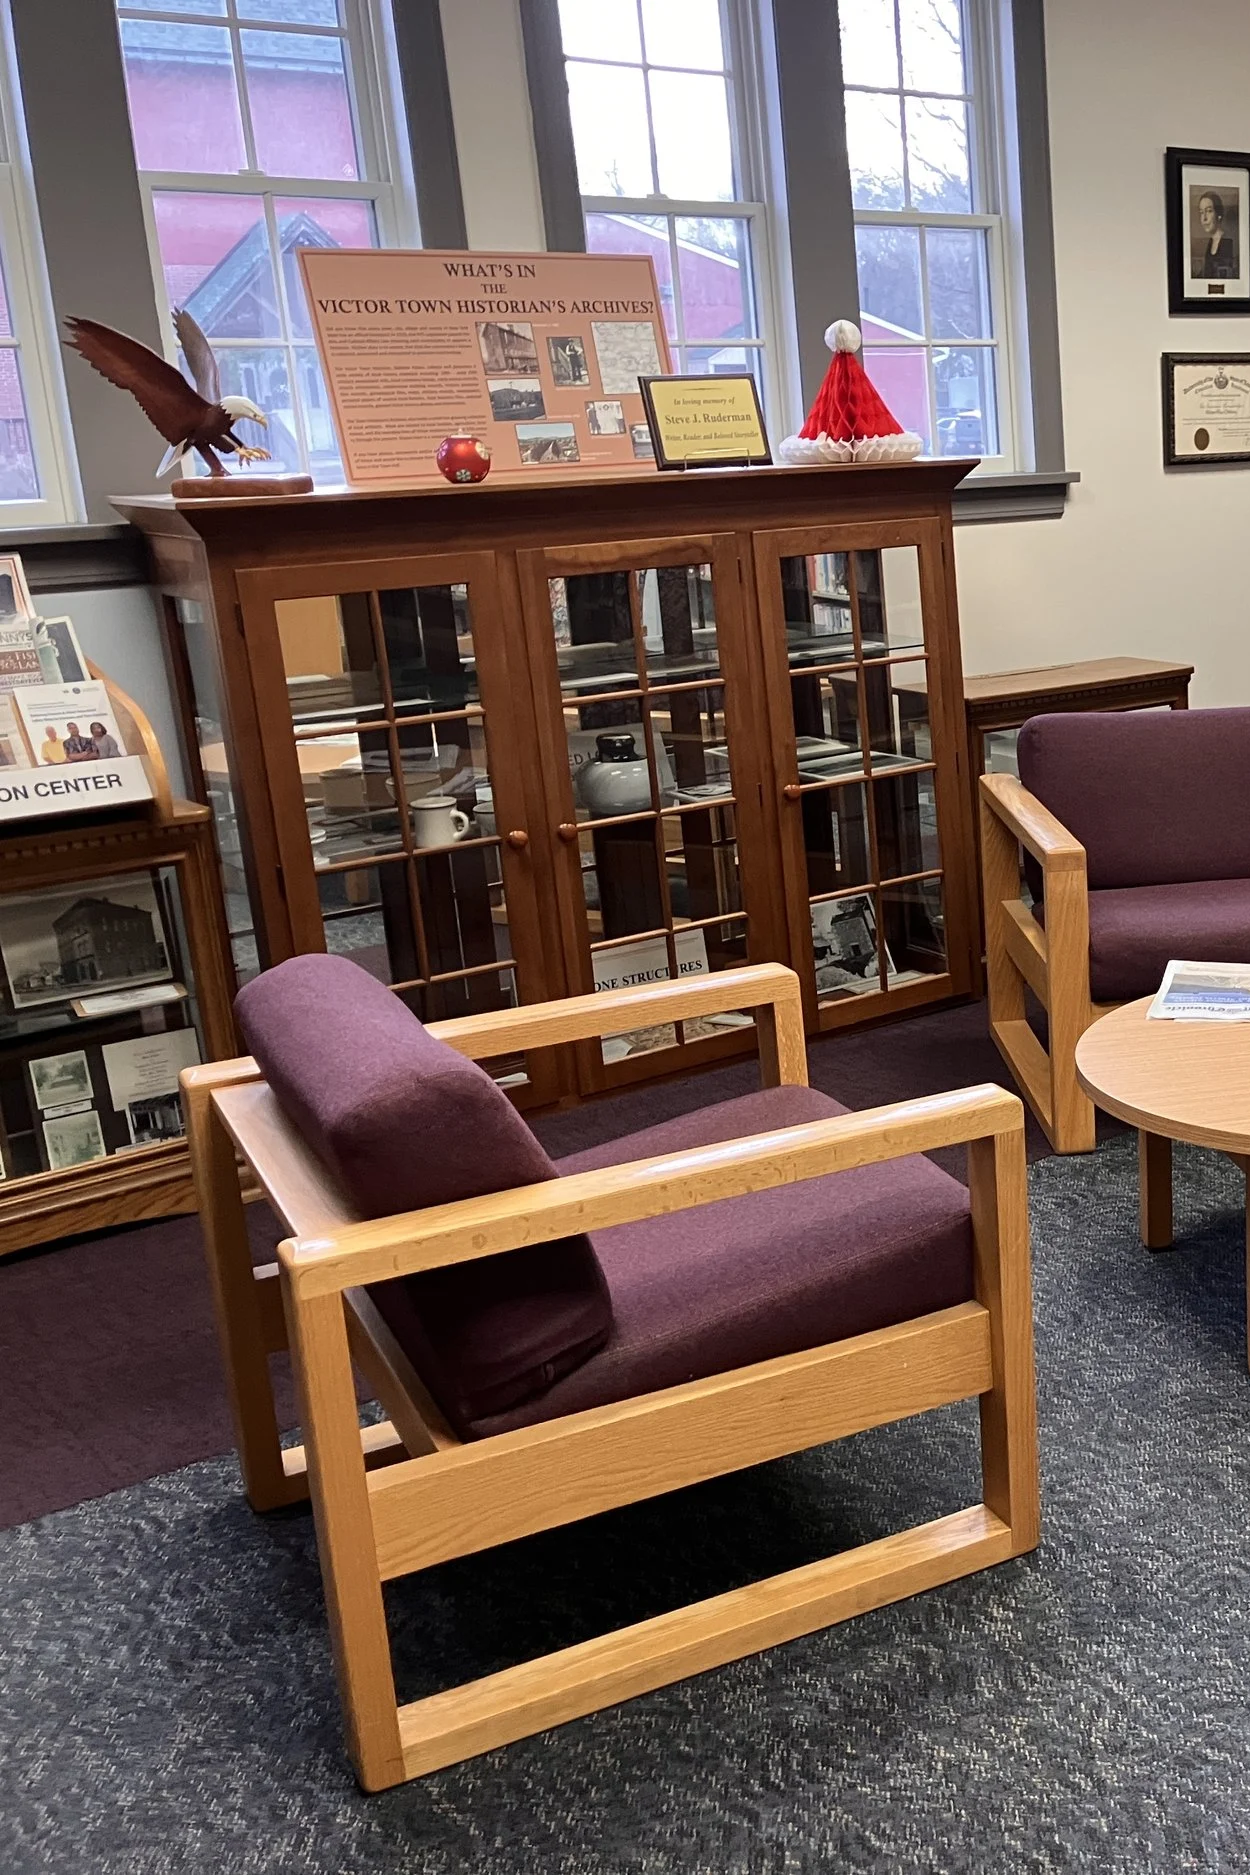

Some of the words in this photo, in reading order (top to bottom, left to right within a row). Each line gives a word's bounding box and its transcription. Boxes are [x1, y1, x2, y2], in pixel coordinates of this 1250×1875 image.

[443, 263, 513, 278] WHAT'S
[516, 264, 537, 278] IN
[480, 283, 508, 294] THE
[317, 299, 392, 314] VICTOR
[395, 299, 451, 314] TOWN
[457, 299, 567, 314] HISTORIAN'S
[570, 299, 654, 314] ARCHIVES?
[665, 414, 691, 425] Steve
[692, 413, 701, 424] J.
[703, 412, 752, 424] Ruderman
[34, 774, 123, 797] CENTER
[622, 960, 703, 986] STRUCTRES
